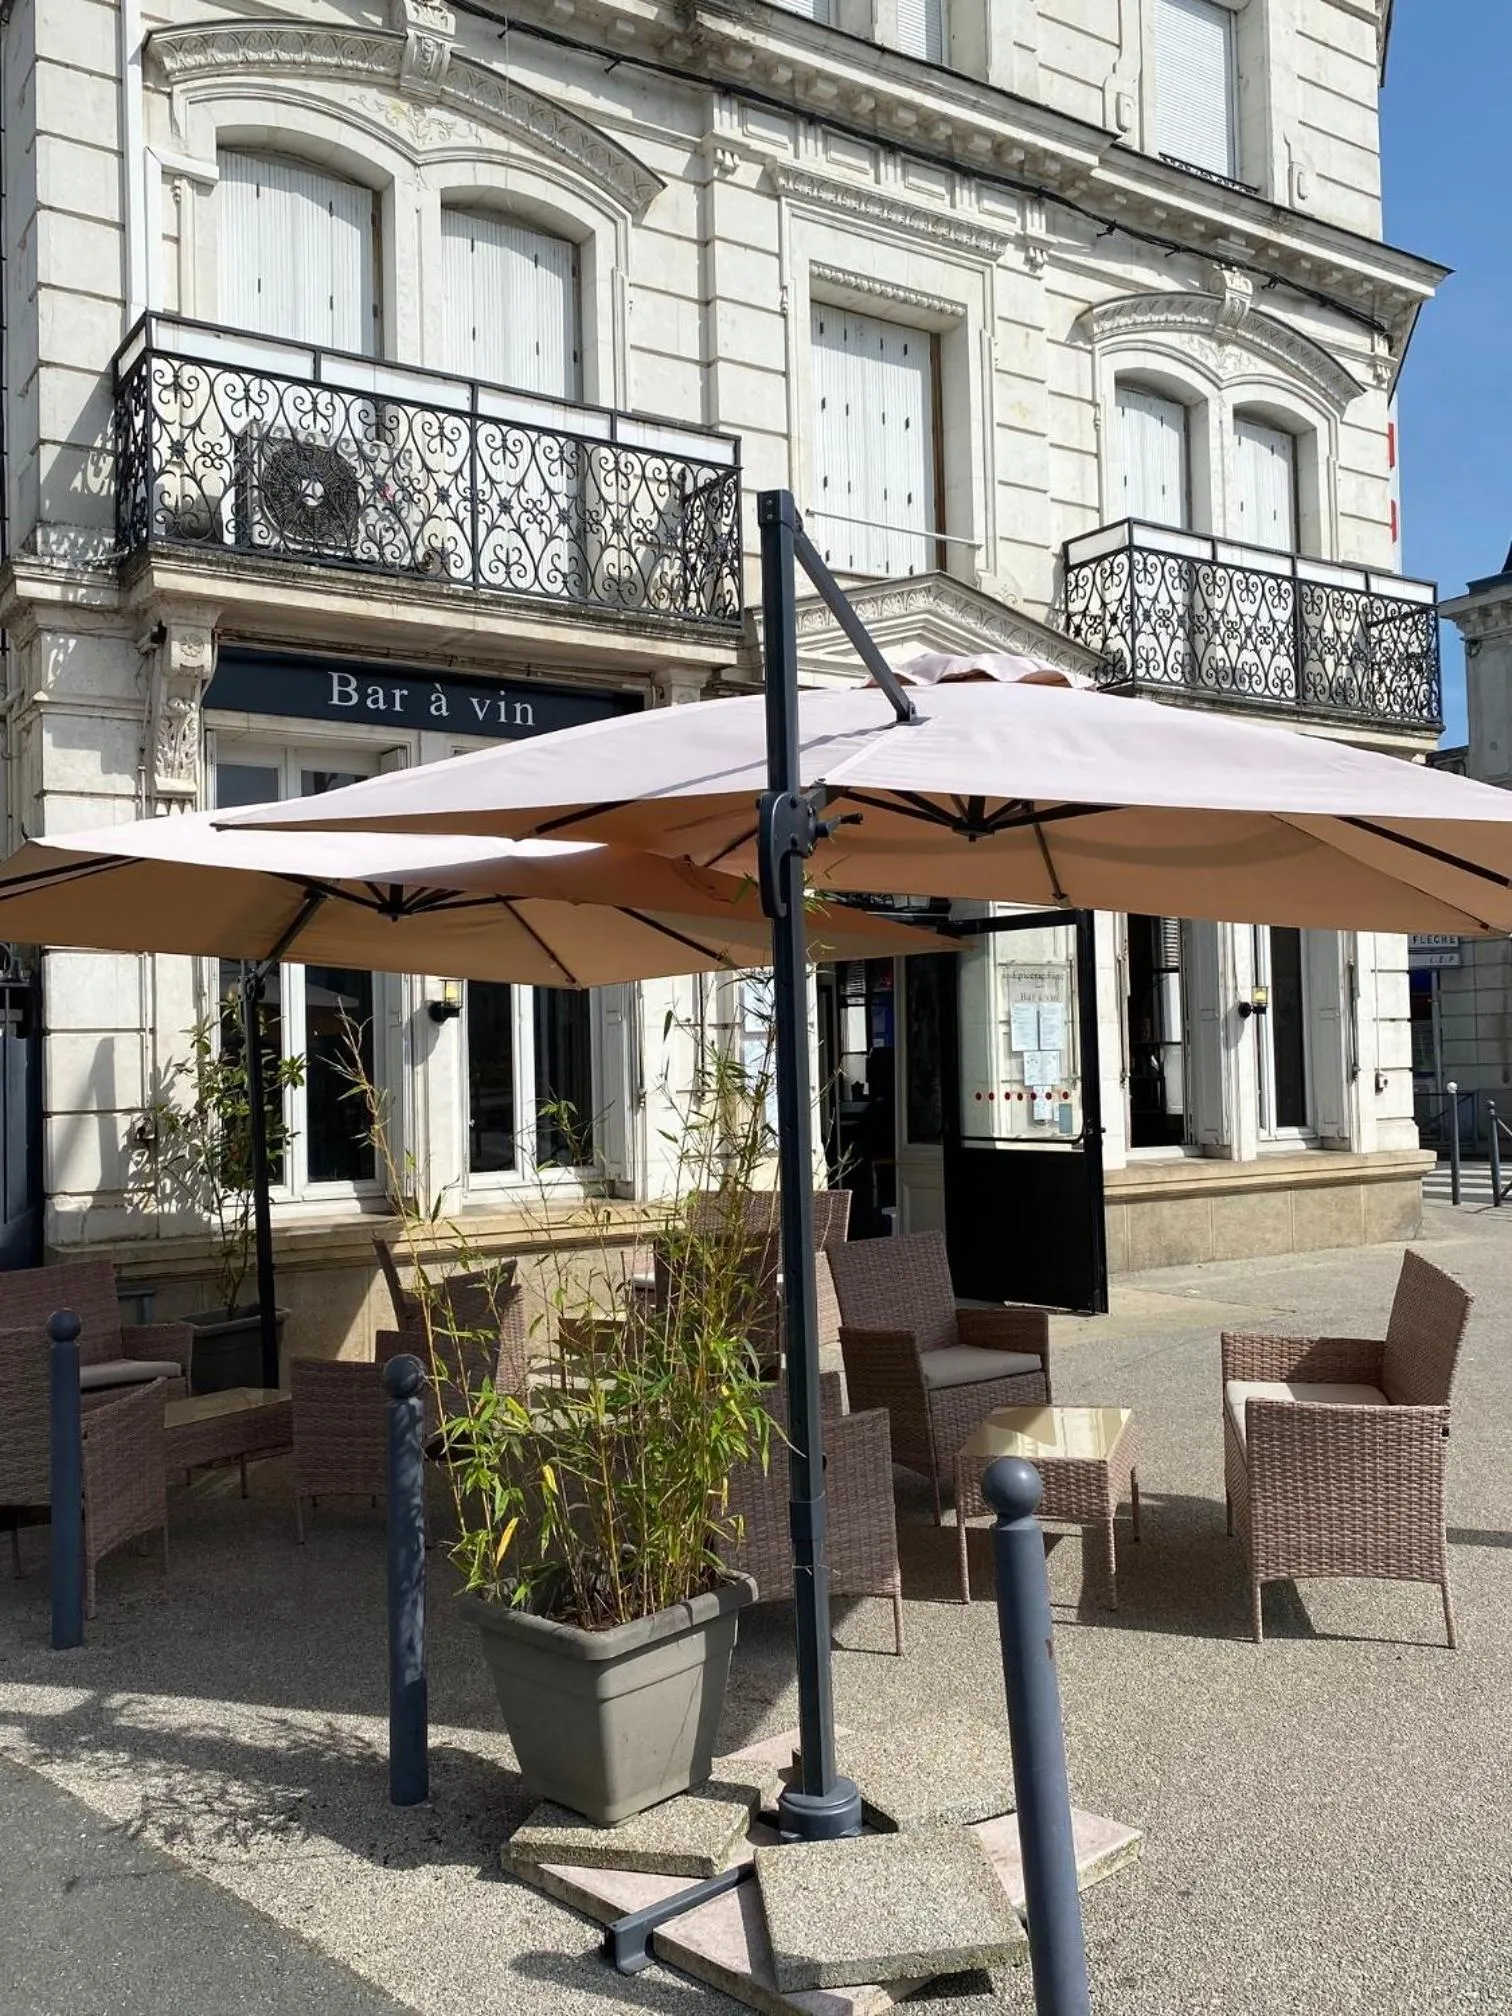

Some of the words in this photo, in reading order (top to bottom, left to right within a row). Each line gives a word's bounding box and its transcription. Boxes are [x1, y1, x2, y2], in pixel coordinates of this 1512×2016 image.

[328, 671, 408, 712] Bar
[429, 682, 450, 717] à
[469, 690, 536, 726] vin
